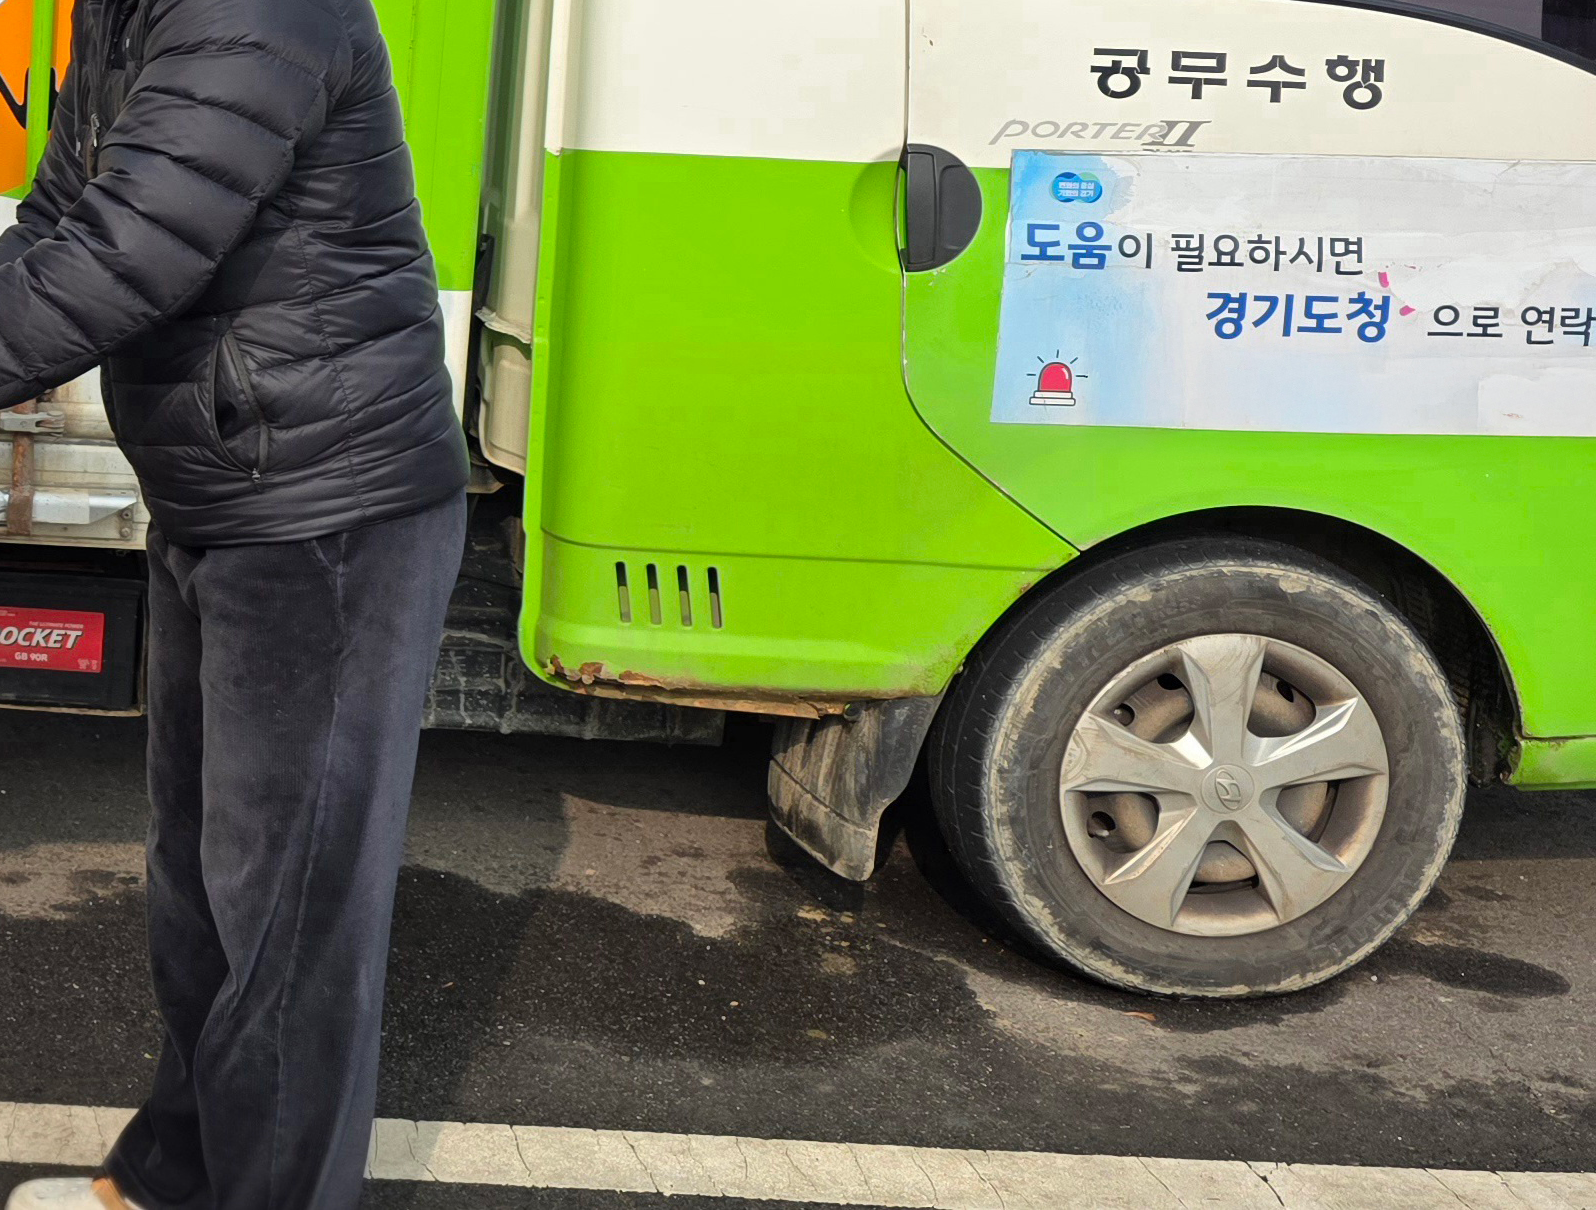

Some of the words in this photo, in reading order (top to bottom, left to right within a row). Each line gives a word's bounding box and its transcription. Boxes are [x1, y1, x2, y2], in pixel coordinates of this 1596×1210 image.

[1090, 47, 1386, 111] 공무수행
[1020, 221, 1153, 270] 도움이
[1170, 233, 1364, 277] 필요하시면
[1205, 290, 1392, 344] 경기도청
[1427, 304, 1503, 338] 으로
[14, 651, 28, 661] GB
[29, 652, 49, 662] 90R
